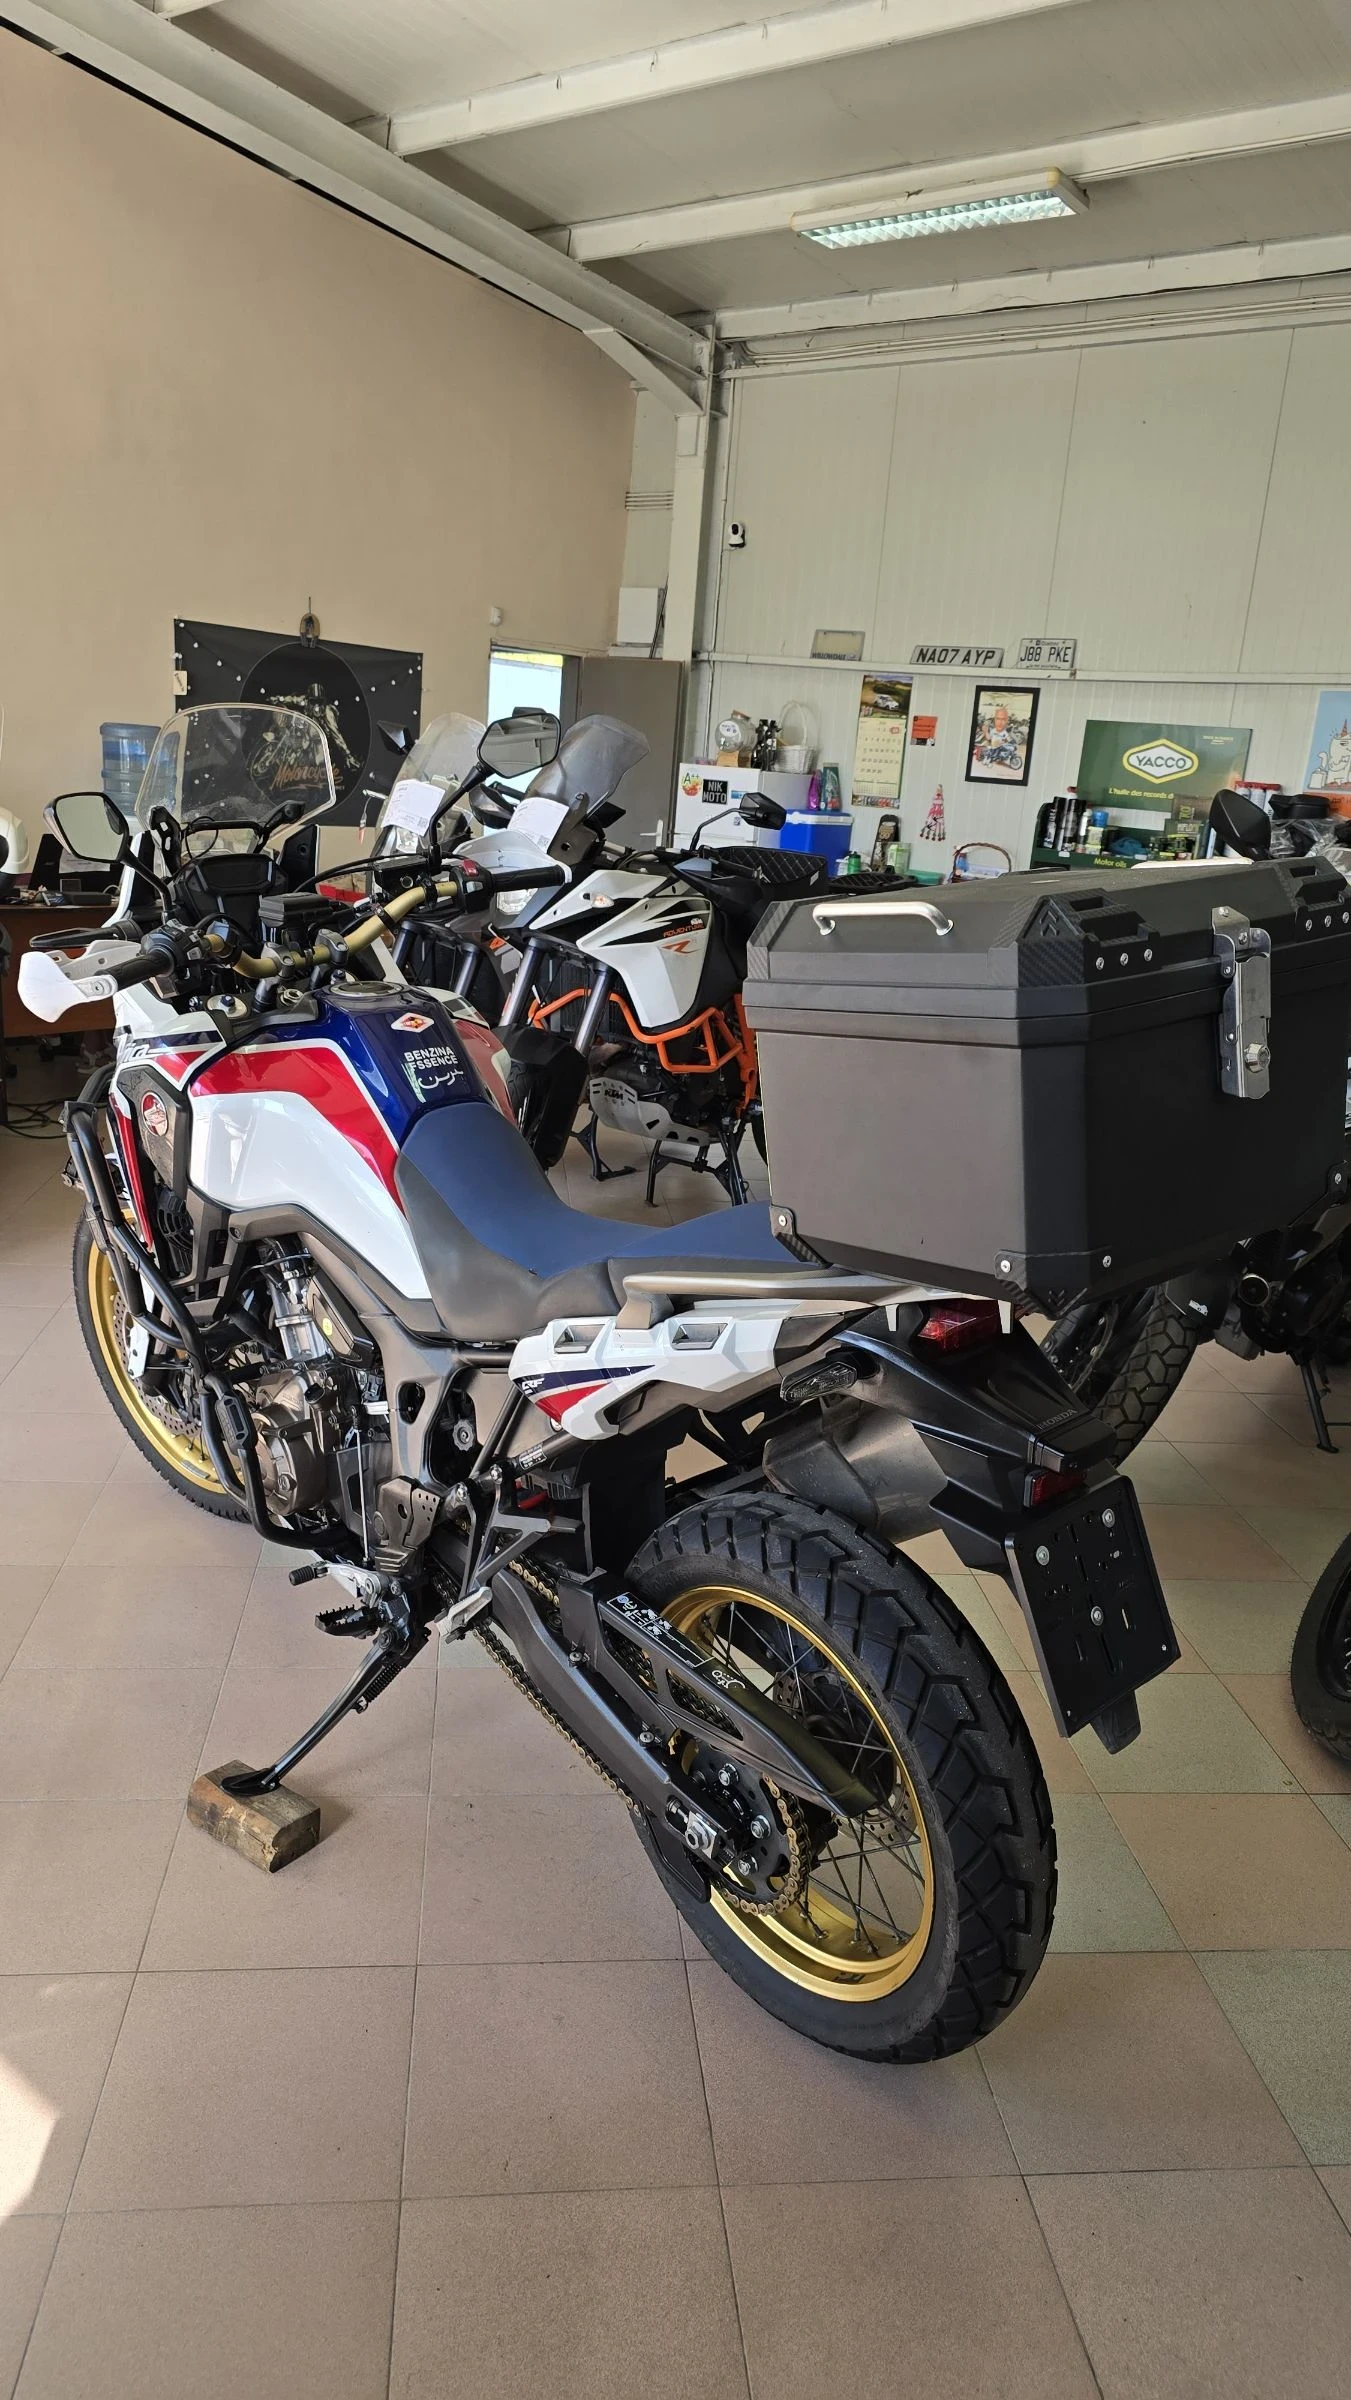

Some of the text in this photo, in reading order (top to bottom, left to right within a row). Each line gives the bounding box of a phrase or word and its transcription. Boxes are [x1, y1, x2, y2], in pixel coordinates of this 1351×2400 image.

[961, 649, 996, 665] AYP
[1020, 646, 1072, 663] J88 PKE
[1135, 755, 1187, 769] YACCO
[268, 760, 344, 790] Motorcyce
[708, 781, 723, 792] NIK
[1131, 789, 1142, 797] des
[702, 791, 727, 803] MOTO
[1093, 858, 1127, 868] Motor oils
[403, 1046, 454, 1062] BENZINA
[521, 1378, 545, 1390] CRF
[1034, 1409, 1078, 1430] HONDA
